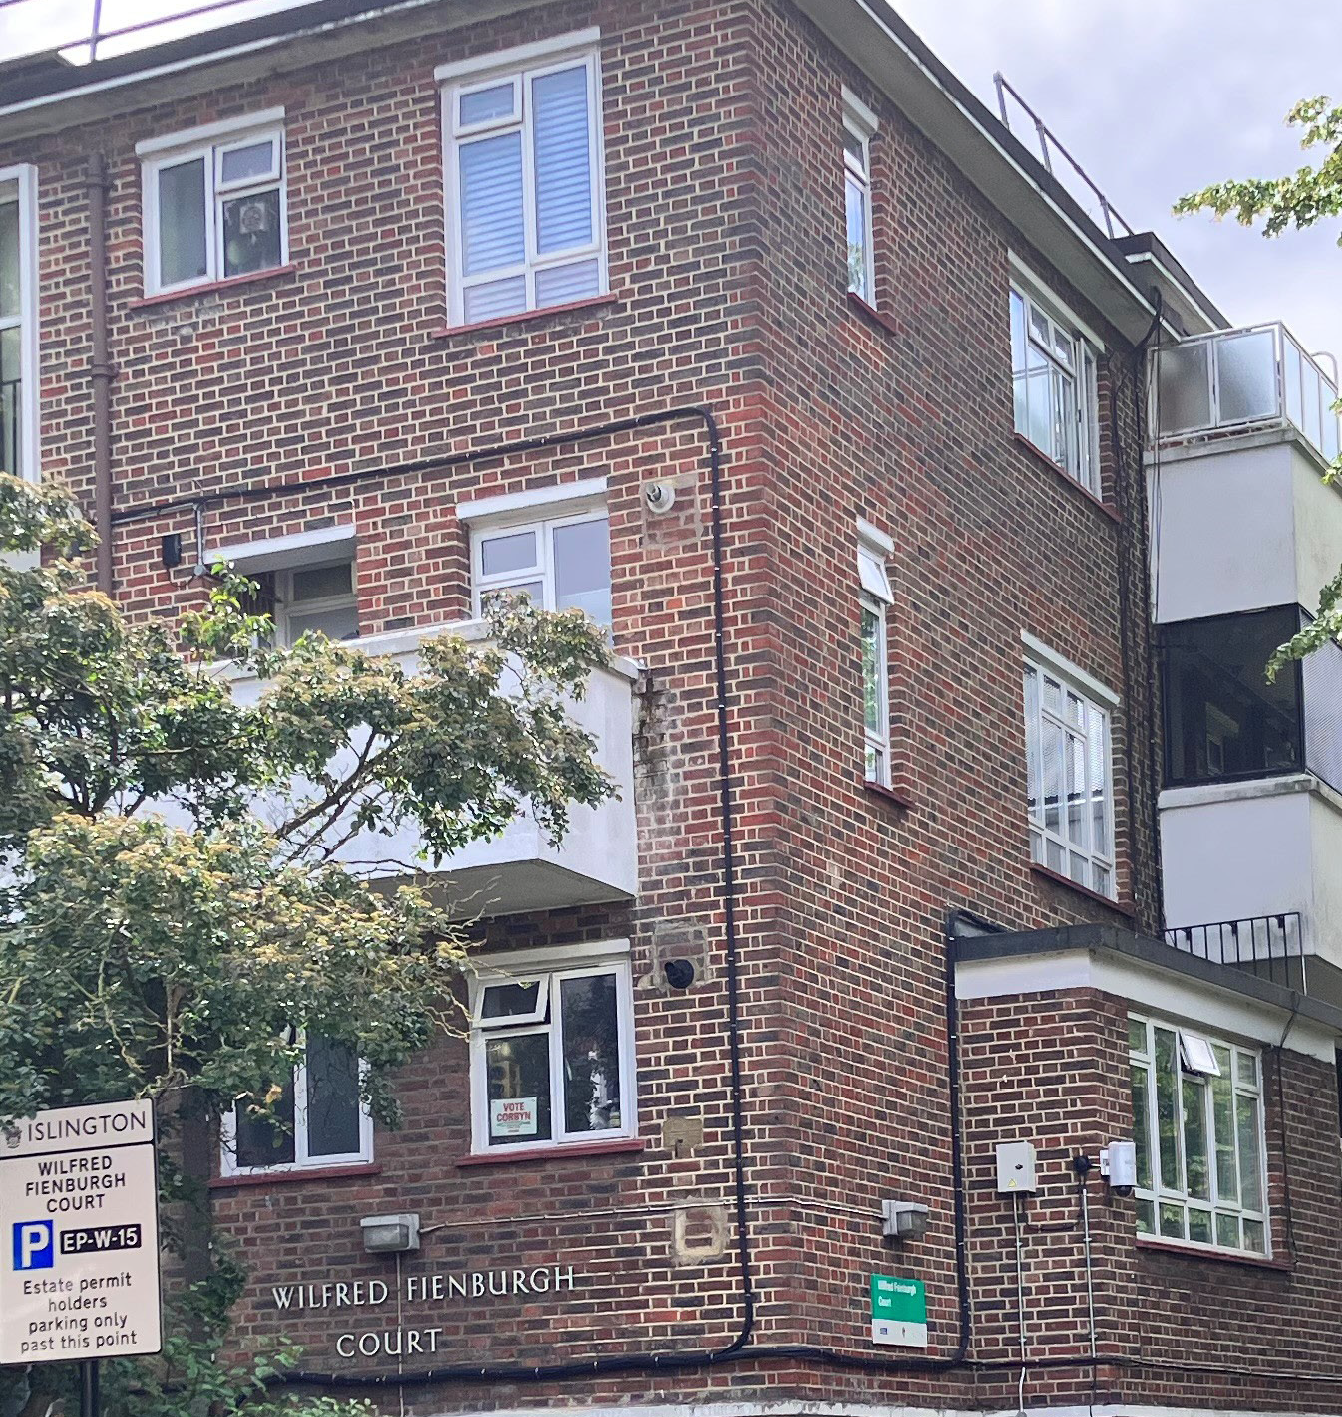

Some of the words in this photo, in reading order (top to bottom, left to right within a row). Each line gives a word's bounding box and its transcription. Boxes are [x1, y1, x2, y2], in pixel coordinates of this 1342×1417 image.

[497, 1111, 531, 1122] CORBYN
[503, 1102, 525, 1111] VOTE
[28, 1111, 146, 1142] ISLINGTON
[38, 1155, 112, 1176] WILFRED
[26, 1173, 126, 1196] FIENBURGH
[47, 1194, 105, 1213] COURT
[21, 1224, 49, 1268] P
[63, 1228, 138, 1252] EP-W-15
[23, 1278, 74, 1295] Estate
[80, 1272, 132, 1292] permit
[271, 1280, 388, 1310] WILFRED
[407, 1265, 575, 1301] FIENBURGH
[48, 1295, 107, 1312] holders
[29, 1315, 88, 1335] parking
[94, 1312, 127, 1329] only
[21, 1336, 54, 1354] past
[61, 1334, 90, 1349] this
[96, 1331, 137, 1348] point
[336, 1328, 443, 1358] COURT
